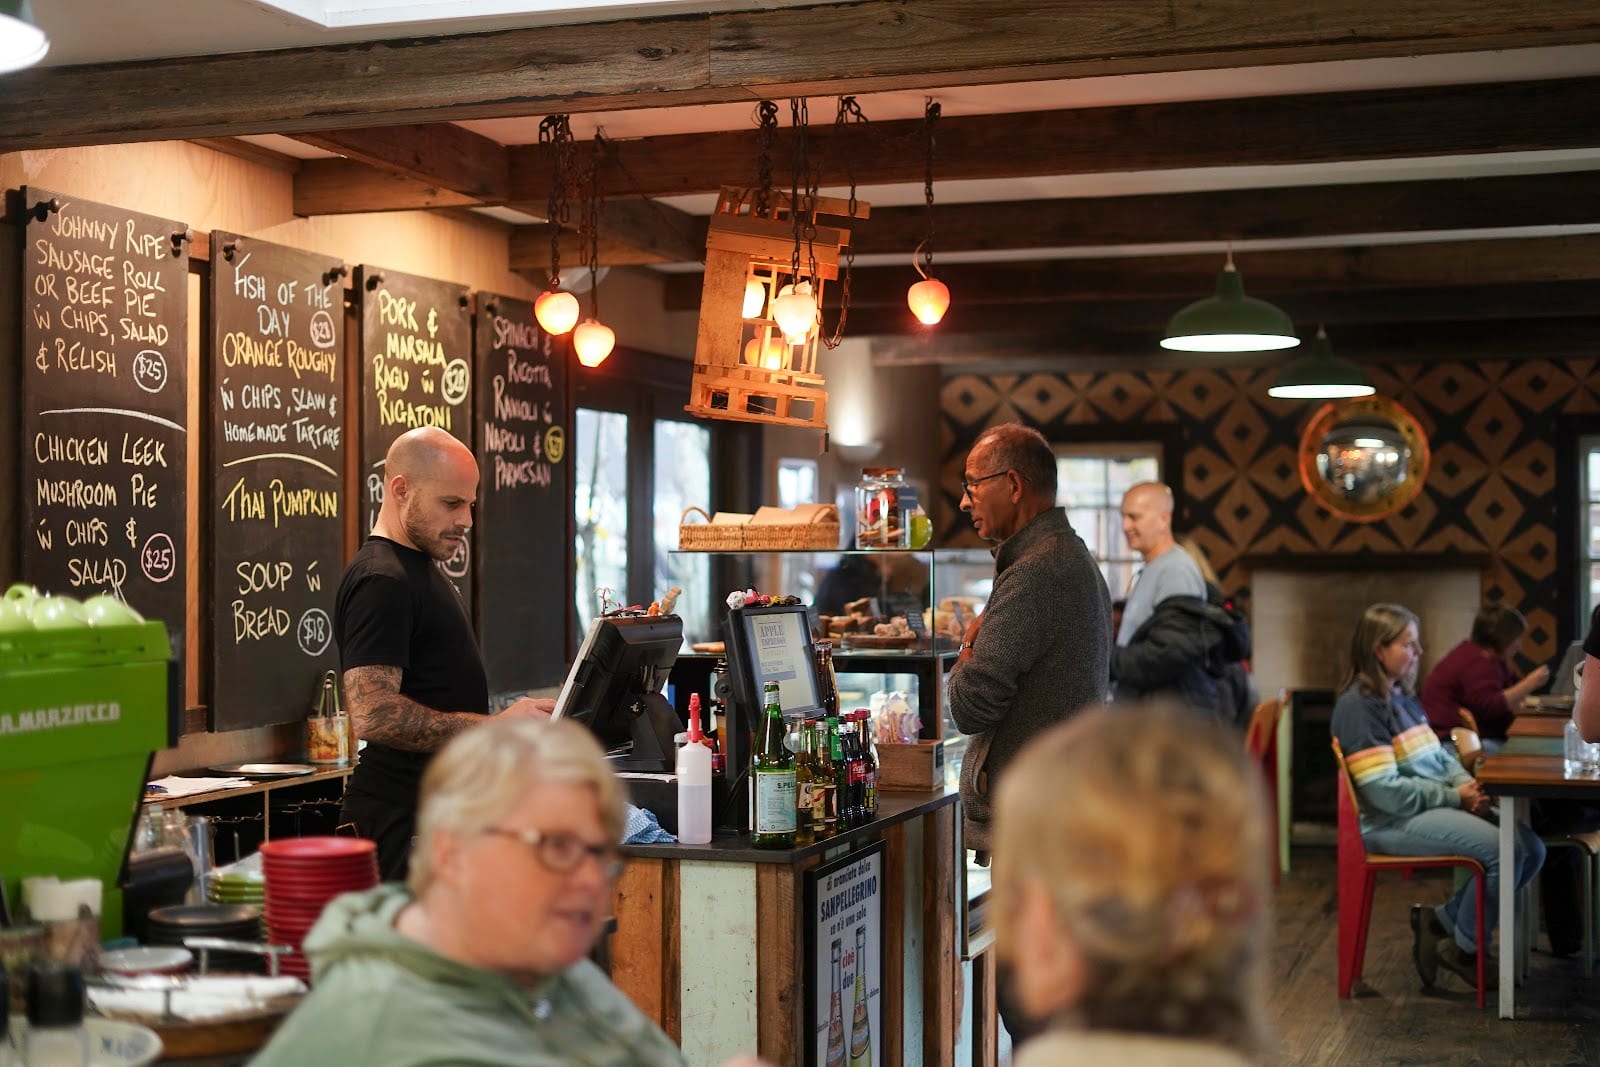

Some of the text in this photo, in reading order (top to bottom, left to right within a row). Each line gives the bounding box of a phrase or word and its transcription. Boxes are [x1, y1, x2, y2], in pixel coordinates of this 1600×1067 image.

[52, 202, 166, 260] JOHNNY RIPE
[36, 239, 166, 292] SAUSAGE ROLL
[234, 252, 333, 309] FISH OF THE
[34, 274, 157, 317] OR BEEF PIE
[378, 288, 439, 339] PORK &
[119, 317, 169, 347] SALAD
[257, 304, 290, 338] DAY
[35, 338, 117, 377] & RELISH
[137, 354, 162, 380] $25
[223, 332, 336, 383] ORANGE ROUGHY
[386, 332, 448, 369] MARSALA
[372, 353, 409, 392] RAGU
[291, 387, 326, 413] SLAW
[329, 394, 337, 419] &
[376, 389, 452, 431] RIGATONI
[35, 432, 168, 468] CHICKEN LEEK
[224, 417, 341, 451] HOMEMADE TARTARE
[484, 421, 526, 453] NAPOLI
[36, 473, 158, 510] MUSHROOM PIE
[494, 455, 550, 491] PARMESAN
[269, 478, 337, 529] PUMPKIN
[65, 517, 109, 546] CHIPS
[125, 516, 138, 549] &
[68, 558, 127, 588] SALAD
[144, 549, 171, 572] $25
[236, 561, 293, 595] SOUP
[231, 599, 290, 645] BREAD
[303, 615, 325, 646] $18
[820, 875, 877, 922] SANPELLEGRINO
